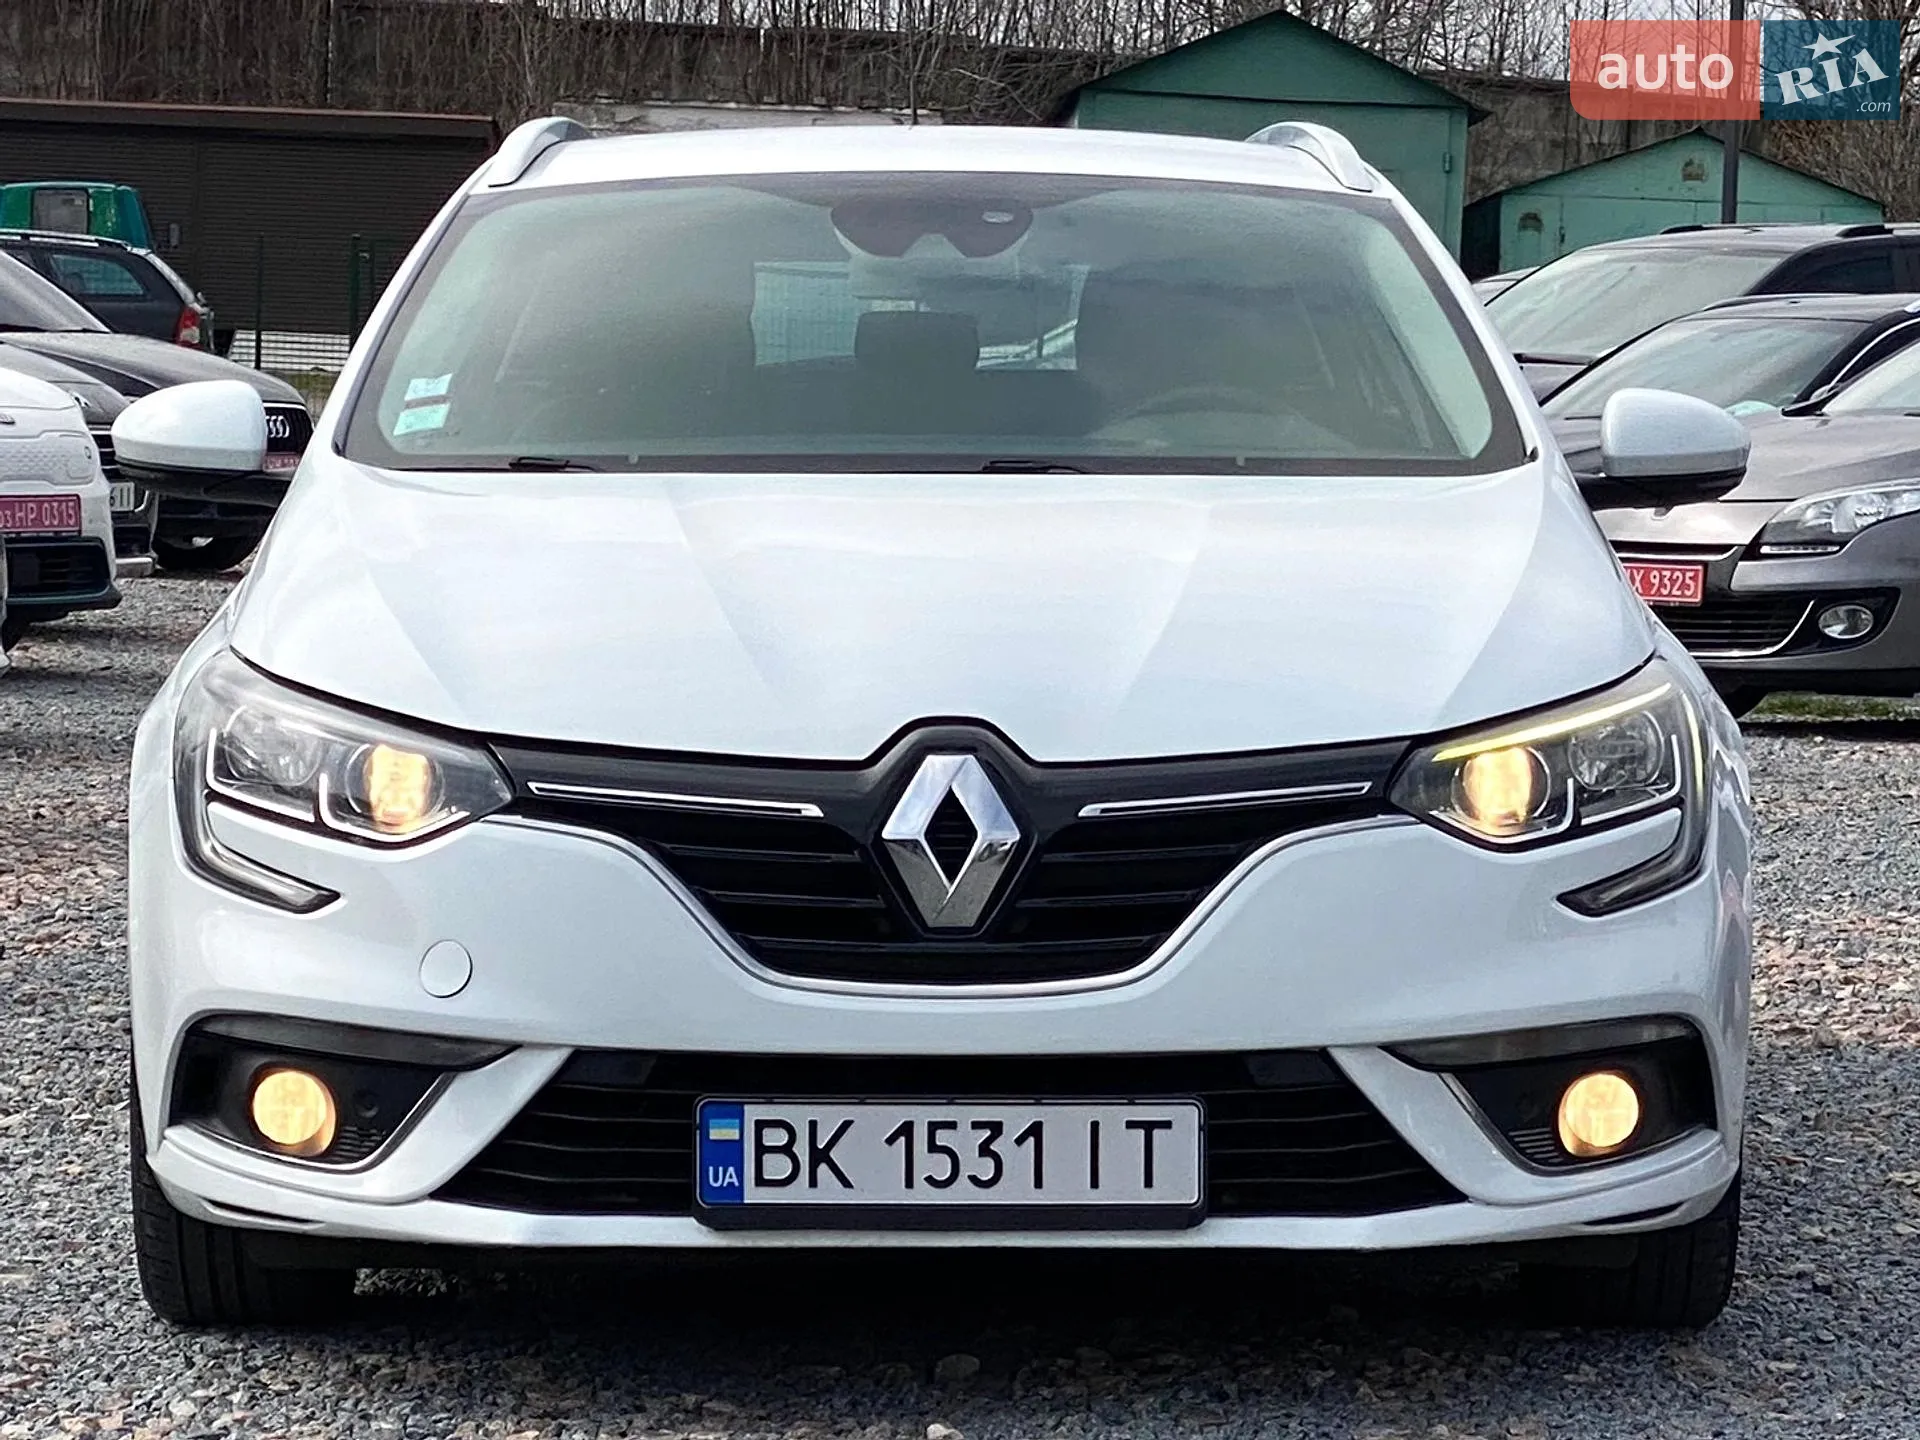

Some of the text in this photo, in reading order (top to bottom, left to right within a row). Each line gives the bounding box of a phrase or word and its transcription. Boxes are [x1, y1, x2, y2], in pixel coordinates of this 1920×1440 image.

[42, 502, 75, 526] 0315
[1649, 569, 1695, 596] 9325
[754, 1118, 1173, 1189] BK 1531 IT
[708, 1165, 740, 1188] UA
